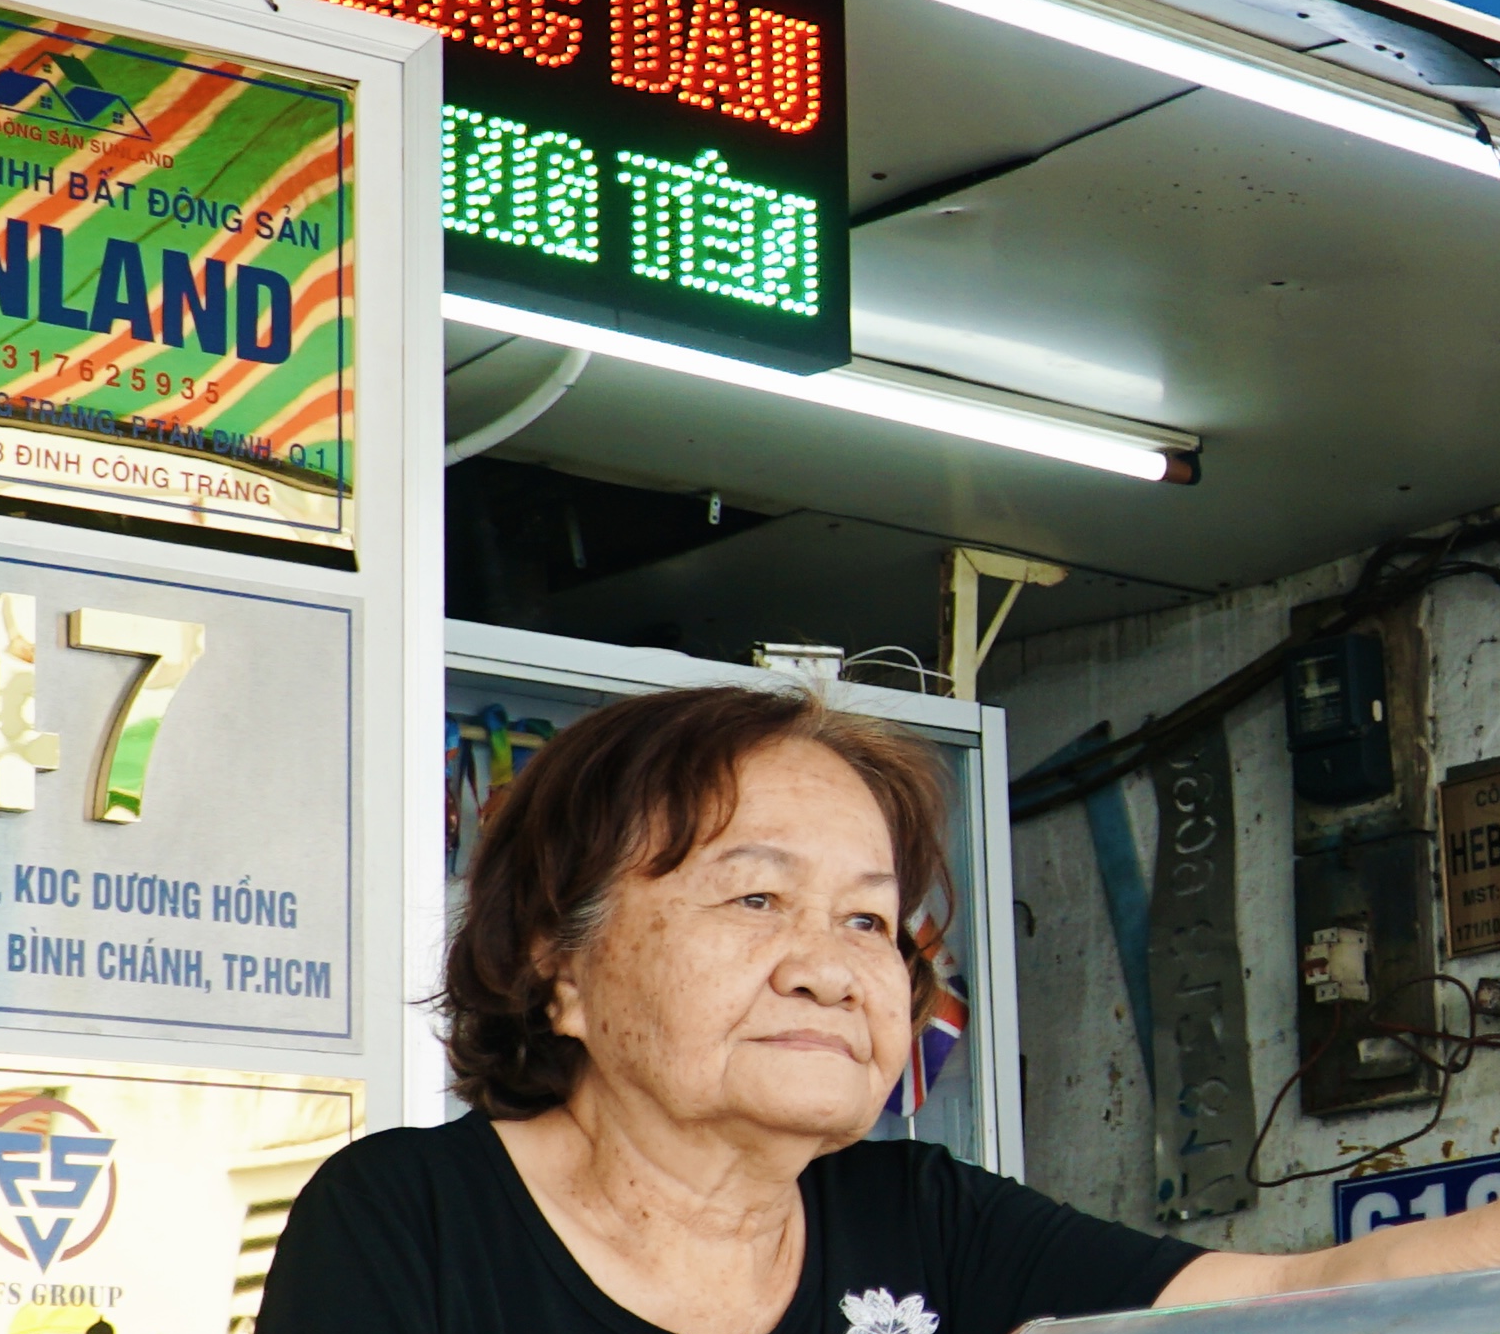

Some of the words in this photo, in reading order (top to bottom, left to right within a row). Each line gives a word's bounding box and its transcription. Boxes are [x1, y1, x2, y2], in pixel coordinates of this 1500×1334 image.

[69, 167, 137, 211] BẤT
[148, 186, 243, 234] ĐỘNG
[255, 204, 321, 251] SẢN
[616, 147, 820, 318] TÊN
[15, 444, 81, 476] ĐINH
[92, 455, 170, 490] CÔNG
[181, 471, 272, 506] TRÁNG
[15, 865, 81, 908] KDC
[93, 870, 202, 921] DƯƠNG
[212, 875, 298, 930] HỒNG
[7, 928, 86, 981] BÌNH
[97, 940, 214, 996] CHÁNH,
[223, 951, 333, 1000] TP.HCM
[31, 1283, 124, 1309] GROUP
